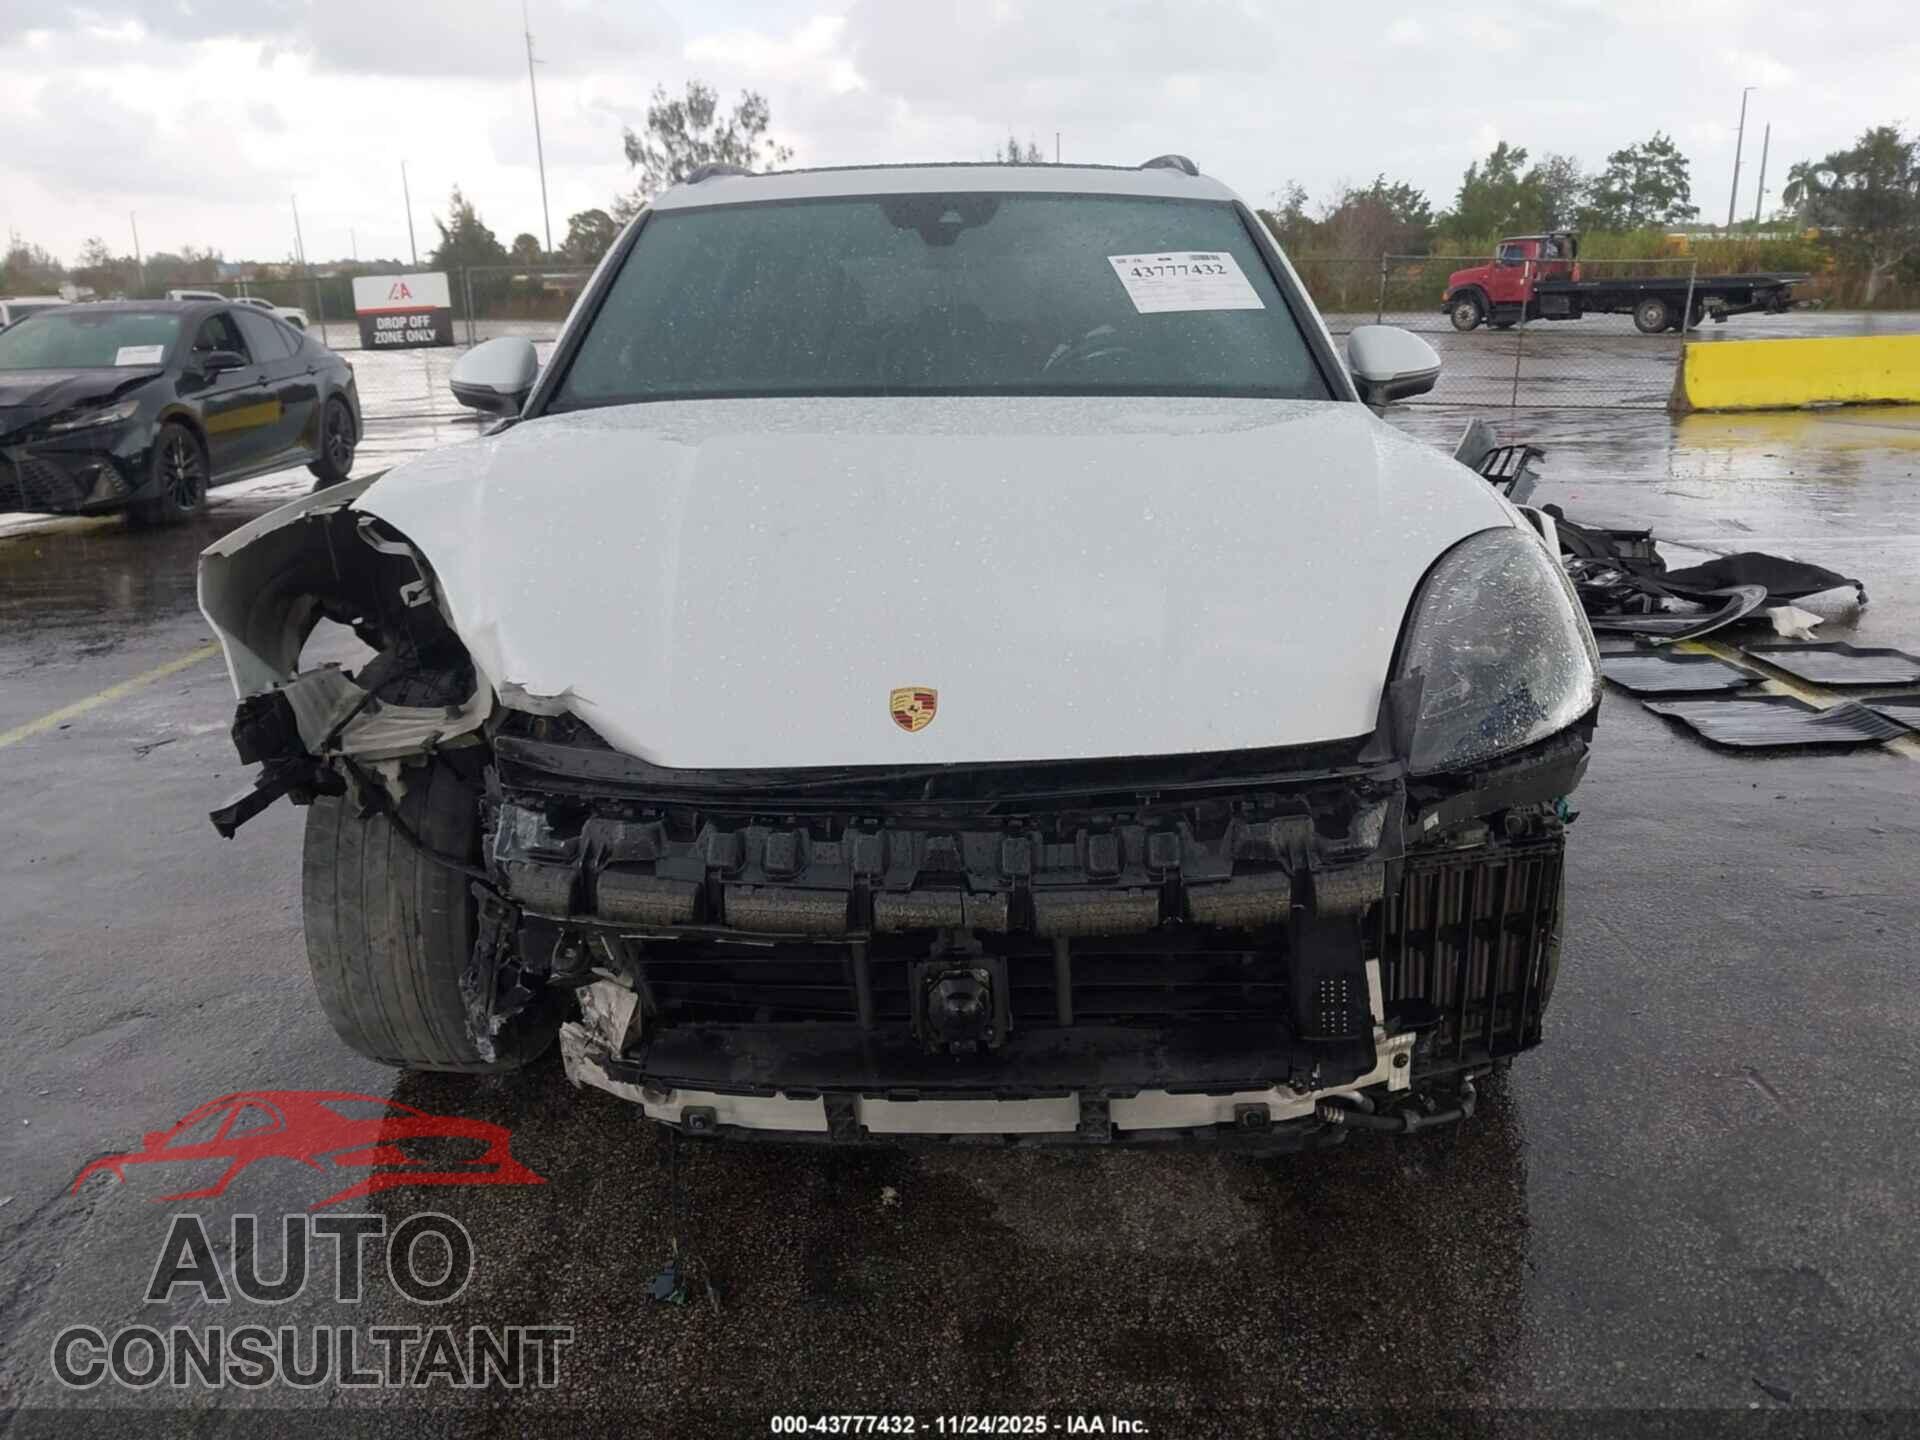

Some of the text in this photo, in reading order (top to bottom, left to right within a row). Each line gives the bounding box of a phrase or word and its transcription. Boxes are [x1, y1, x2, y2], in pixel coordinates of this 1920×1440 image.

[1130, 264, 1228, 278] 43777432
[376, 315, 431, 330] DROP OFF
[373, 329, 437, 344] ZONE ONLY
